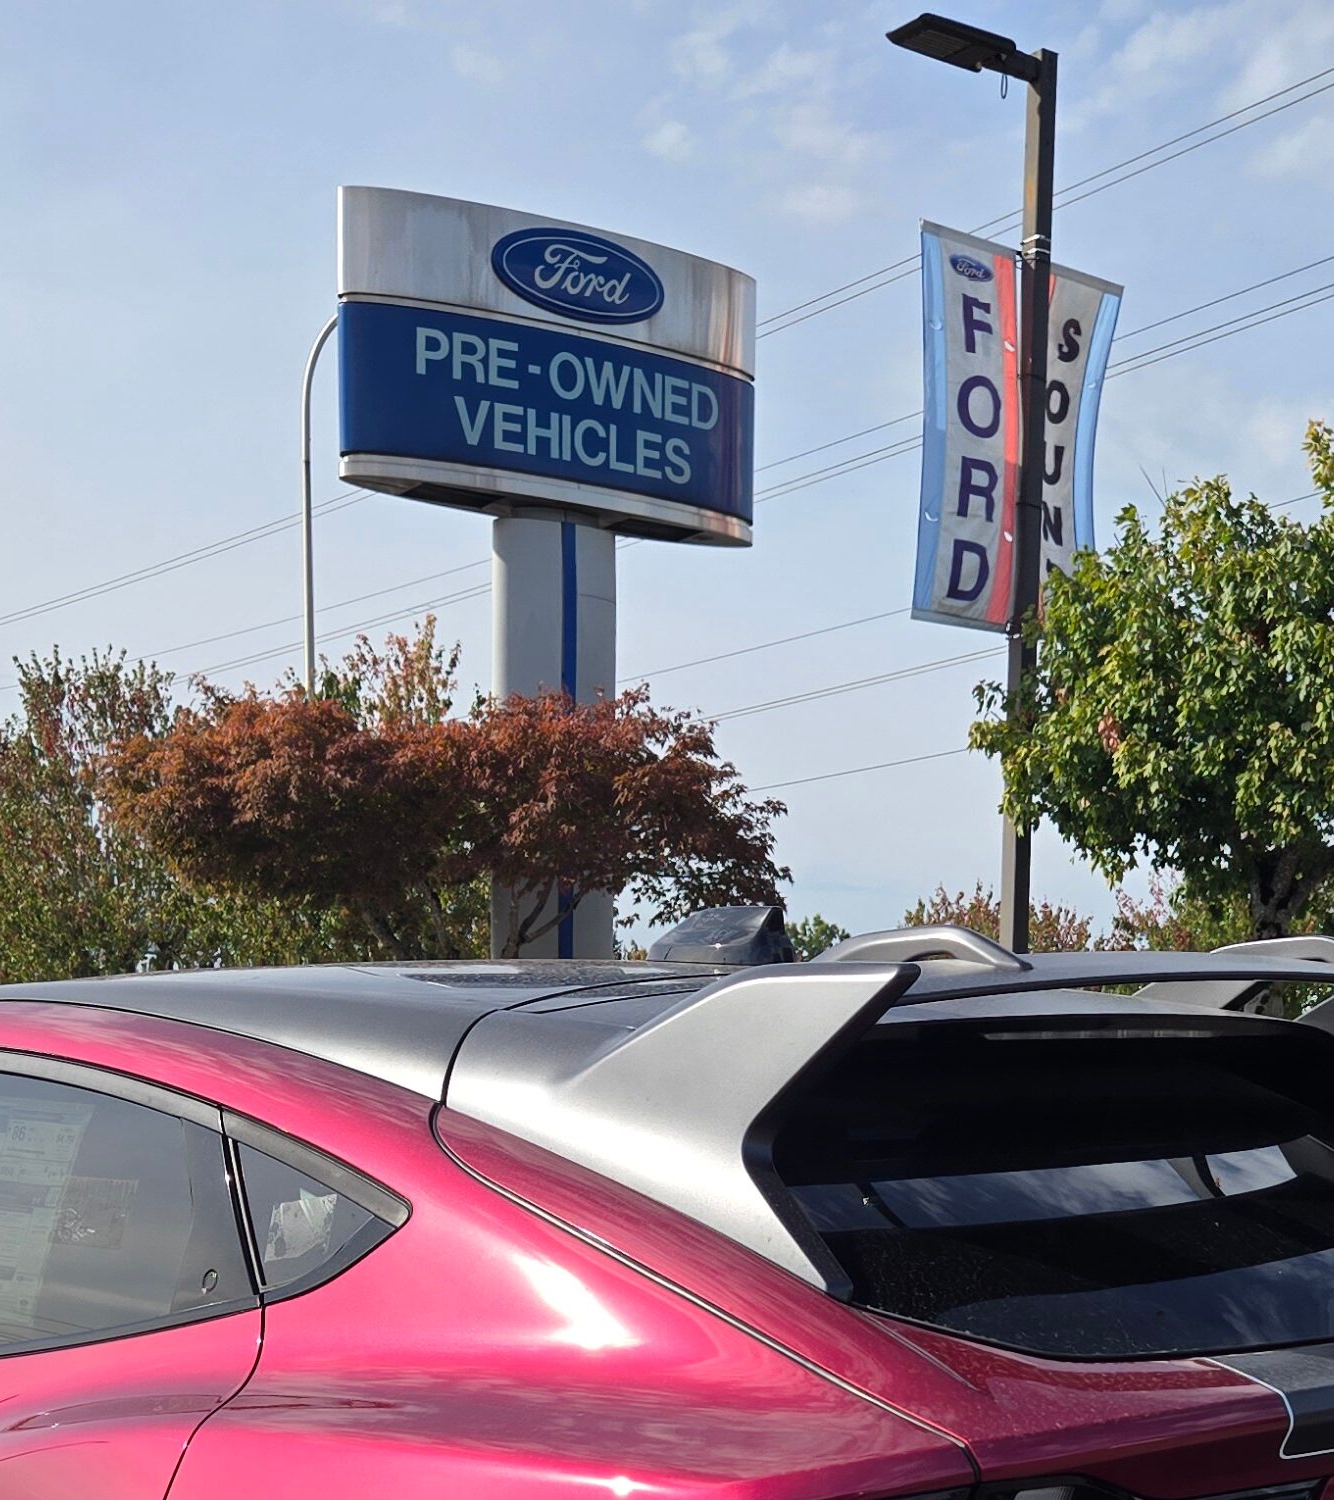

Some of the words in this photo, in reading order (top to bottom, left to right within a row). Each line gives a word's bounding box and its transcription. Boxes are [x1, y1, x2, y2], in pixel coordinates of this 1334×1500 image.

[534, 243, 634, 305] Ford
[454, 395, 692, 485] VEHICLES
[946, 293, 1002, 602] FORD
[1041, 318, 1082, 574] SOUN
